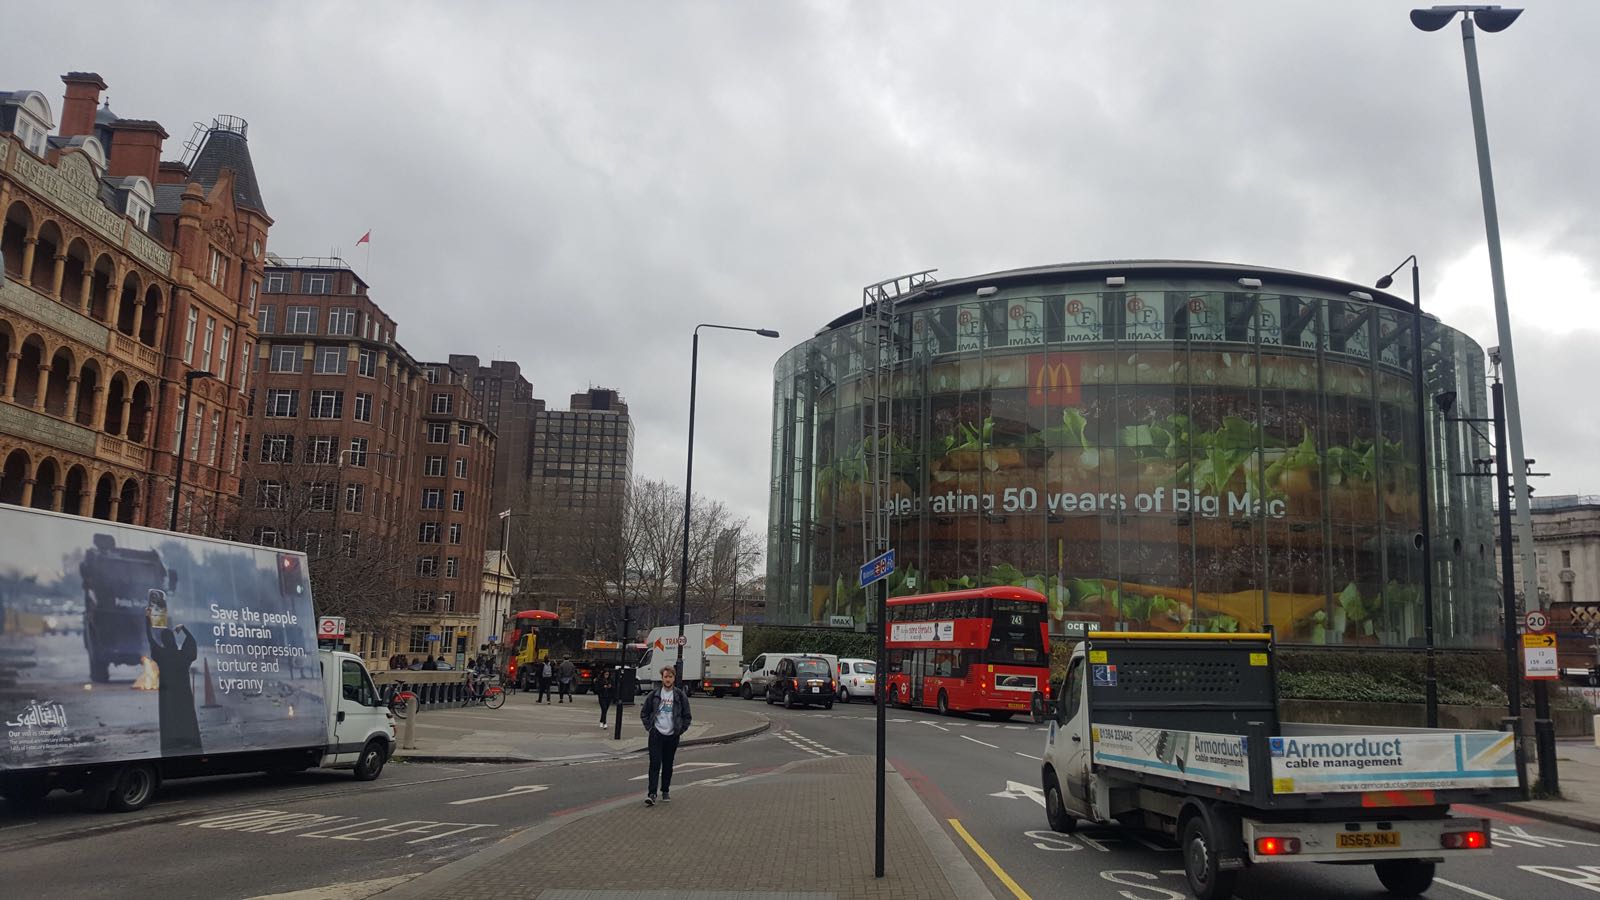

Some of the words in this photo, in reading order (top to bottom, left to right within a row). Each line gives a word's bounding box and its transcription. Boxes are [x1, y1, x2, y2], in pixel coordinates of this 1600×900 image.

[60, 161, 97, 198] ROYAL
[14, 156, 65, 202] HOSPITAL
[81, 200, 125, 241] CHILDREN
[141, 238, 171, 270] WOMEN
[1009, 337, 1040, 346] IMAX
[1067, 333, 1100, 342] IMAX
[1128, 332, 1162, 340] IMAX
[1189, 333, 1223, 341] IMAX
[1302, 341, 1328, 350] IMX
[880, 489, 994, 516] elebrating
[1003, 487, 1038, 512] 50
[1048, 492, 1126, 515] years
[1134, 487, 1165, 512] of
[1173, 488, 1219, 518] Big
[1228, 491, 1286, 519] Mac
[211, 604, 238, 620] Save
[242, 607, 260, 622] the
[263, 611, 297, 628] people
[1010, 615, 1022, 625] 243
[1529, 617, 1545, 627] 20
[213, 623, 226, 637] of
[229, 623, 272, 640] Bahrain
[215, 639, 244, 655] from
[248, 644, 307, 660] oppression,
[217, 659, 257, 673] torture
[261, 659, 279, 673] and
[219, 676, 264, 694] tyranny
[8, 730, 20, 738] Our
[1194, 736, 1243, 758] Armorduct
[1286, 738, 1402, 757] Armorduct
[1195, 754, 1208, 762] cable
[1210, 757, 1243, 767] management
[1286, 759, 1319, 768] cable
[1323, 758, 1403, 769] management
[296, 819, 500, 845] LEFT
[1341, 834, 1370, 846] DS65
[1373, 833, 1397, 845] XNJ
